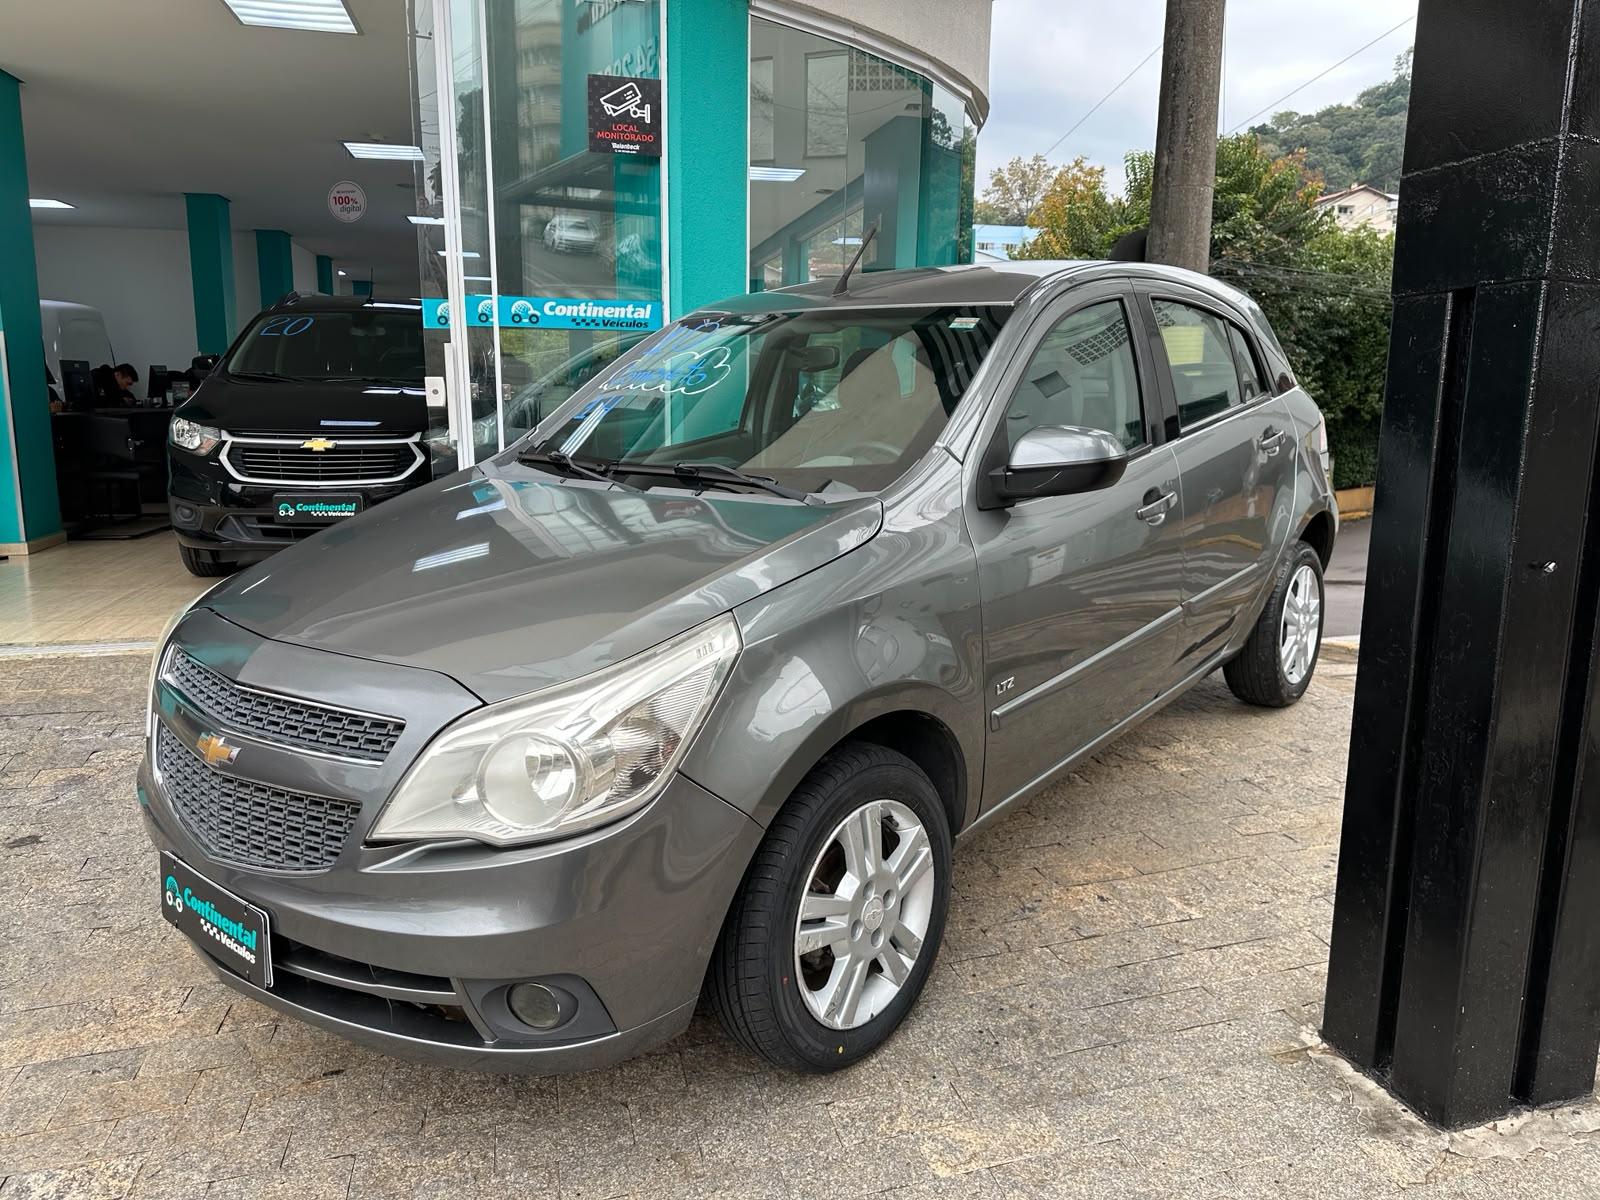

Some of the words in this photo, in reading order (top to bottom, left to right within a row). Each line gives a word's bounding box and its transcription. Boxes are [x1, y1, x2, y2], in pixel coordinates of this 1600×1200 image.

[612, 124, 639, 132] LOCAL
[596, 131, 654, 142] MONITORADO
[333, 195, 359, 206] 100%
[340, 204, 361, 214] digital
[543, 301, 652, 319] Continental
[260, 315, 314, 336] 20
[602, 318, 649, 329] Veículos
[296, 503, 357, 512] Continental
[996, 676, 1015, 696] LTZ
[183, 887, 257, 952] Continental
